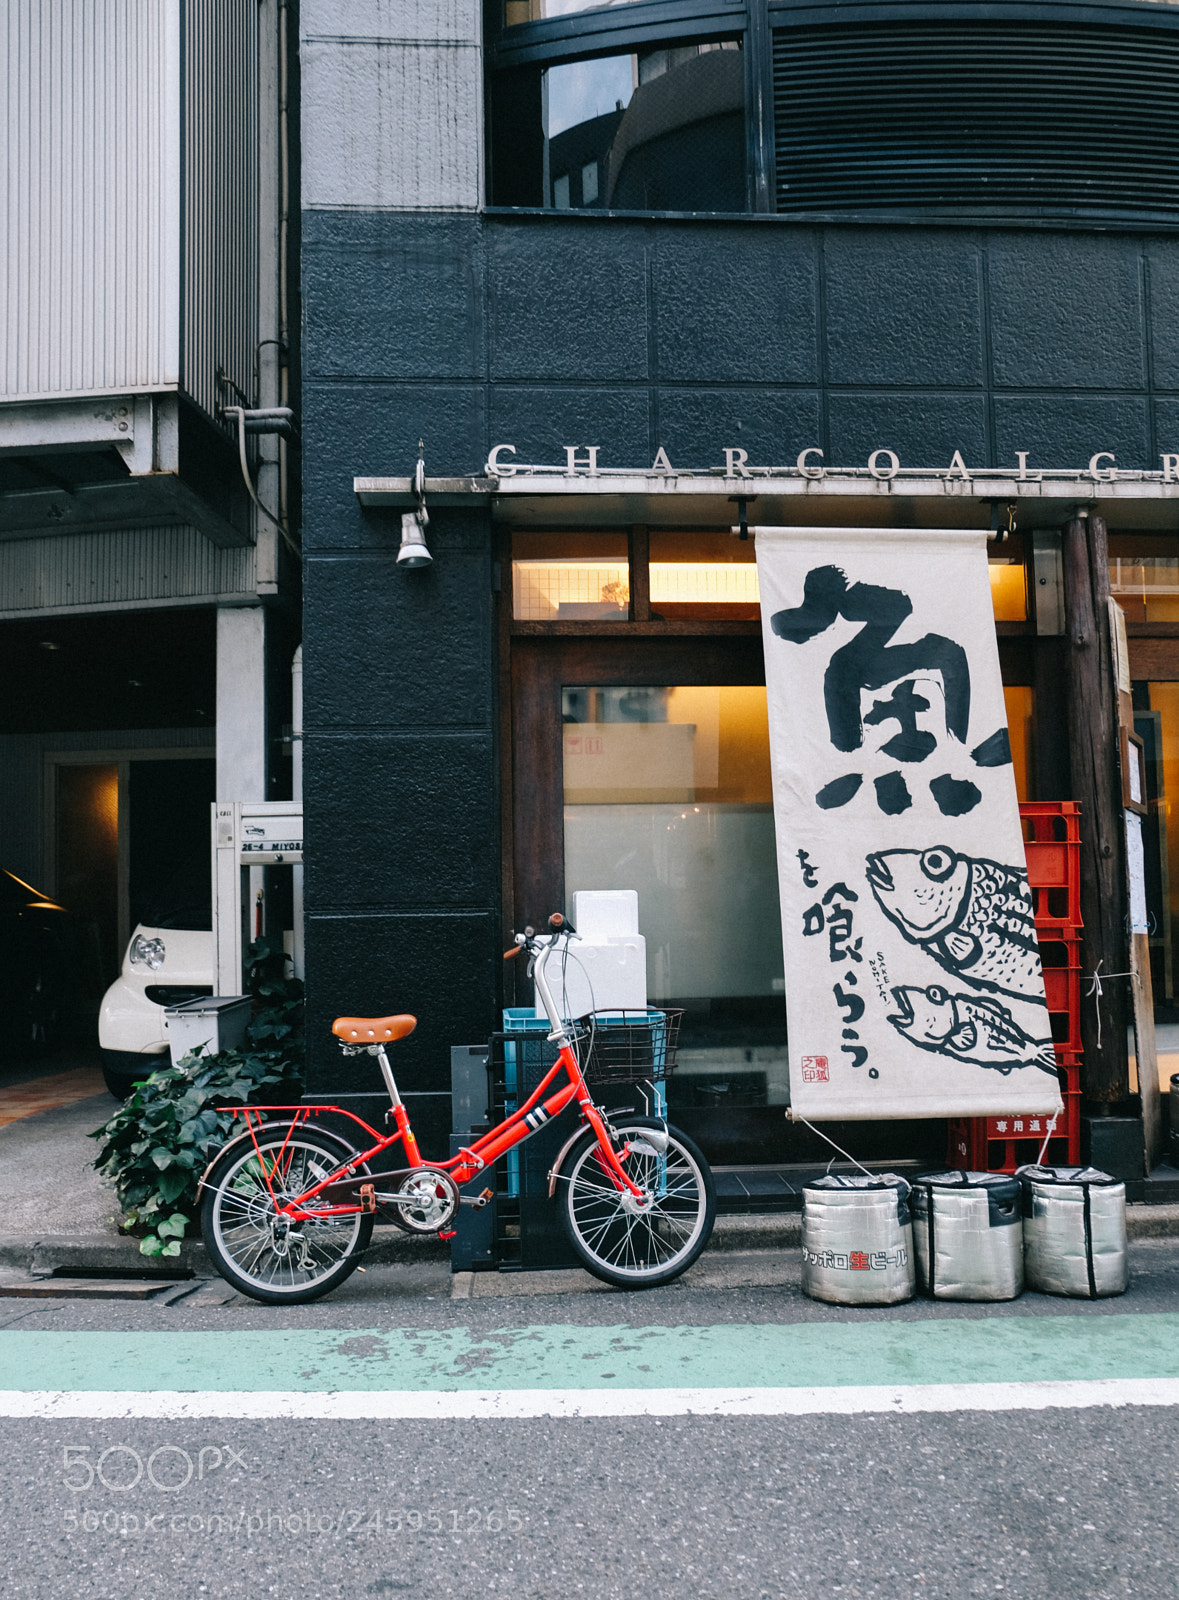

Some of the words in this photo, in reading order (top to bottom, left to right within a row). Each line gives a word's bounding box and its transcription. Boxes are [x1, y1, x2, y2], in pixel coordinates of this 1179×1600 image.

[271, 842, 303, 851] MIYOS
[876, 951, 890, 984] SAKE
[802, 1246, 908, 1270] サッポロ生ビール
